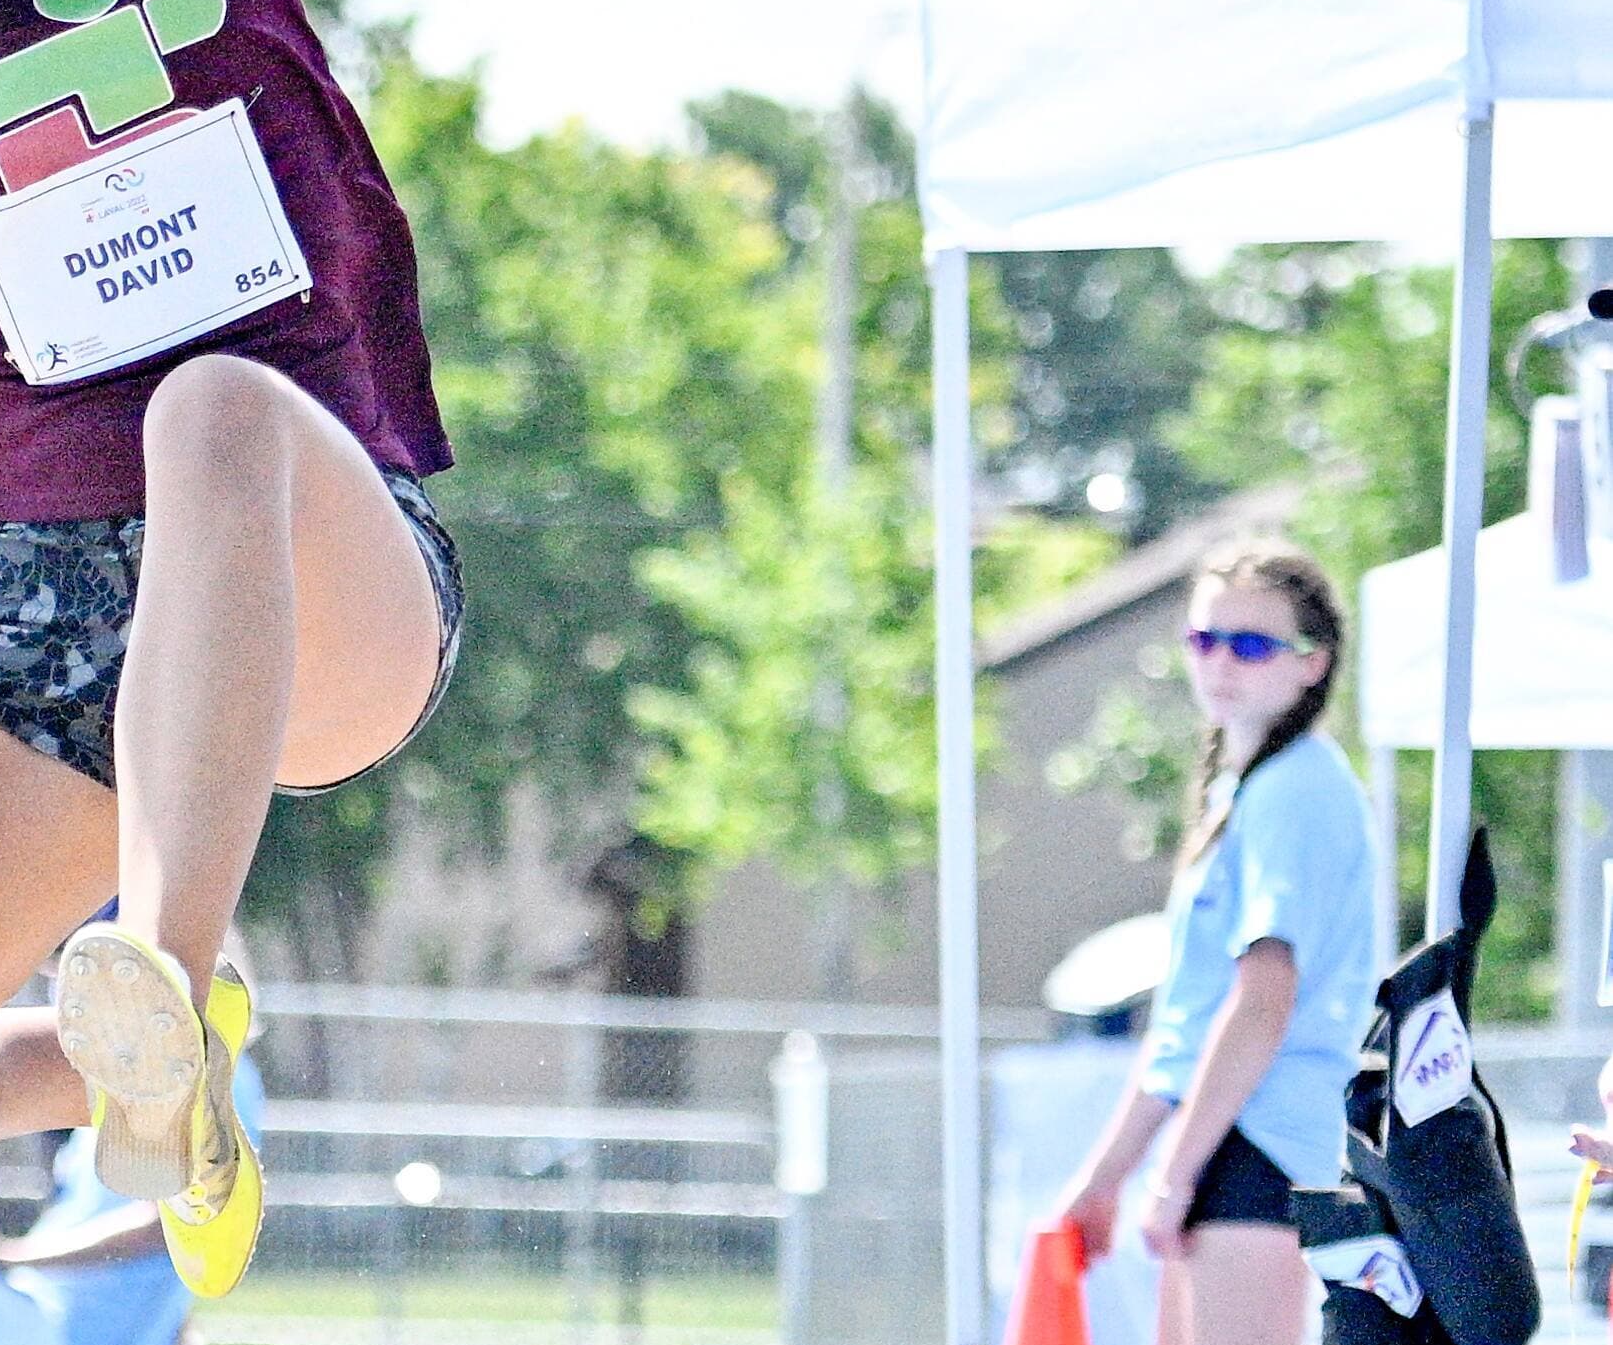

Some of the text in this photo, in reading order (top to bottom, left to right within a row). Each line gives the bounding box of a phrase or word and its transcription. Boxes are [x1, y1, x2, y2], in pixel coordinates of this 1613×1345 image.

[98, 202, 126, 219] LAVAL
[63, 205, 198, 278] DUMONT
[96, 248, 193, 303] DAVID
[235, 259, 283, 293] 854
